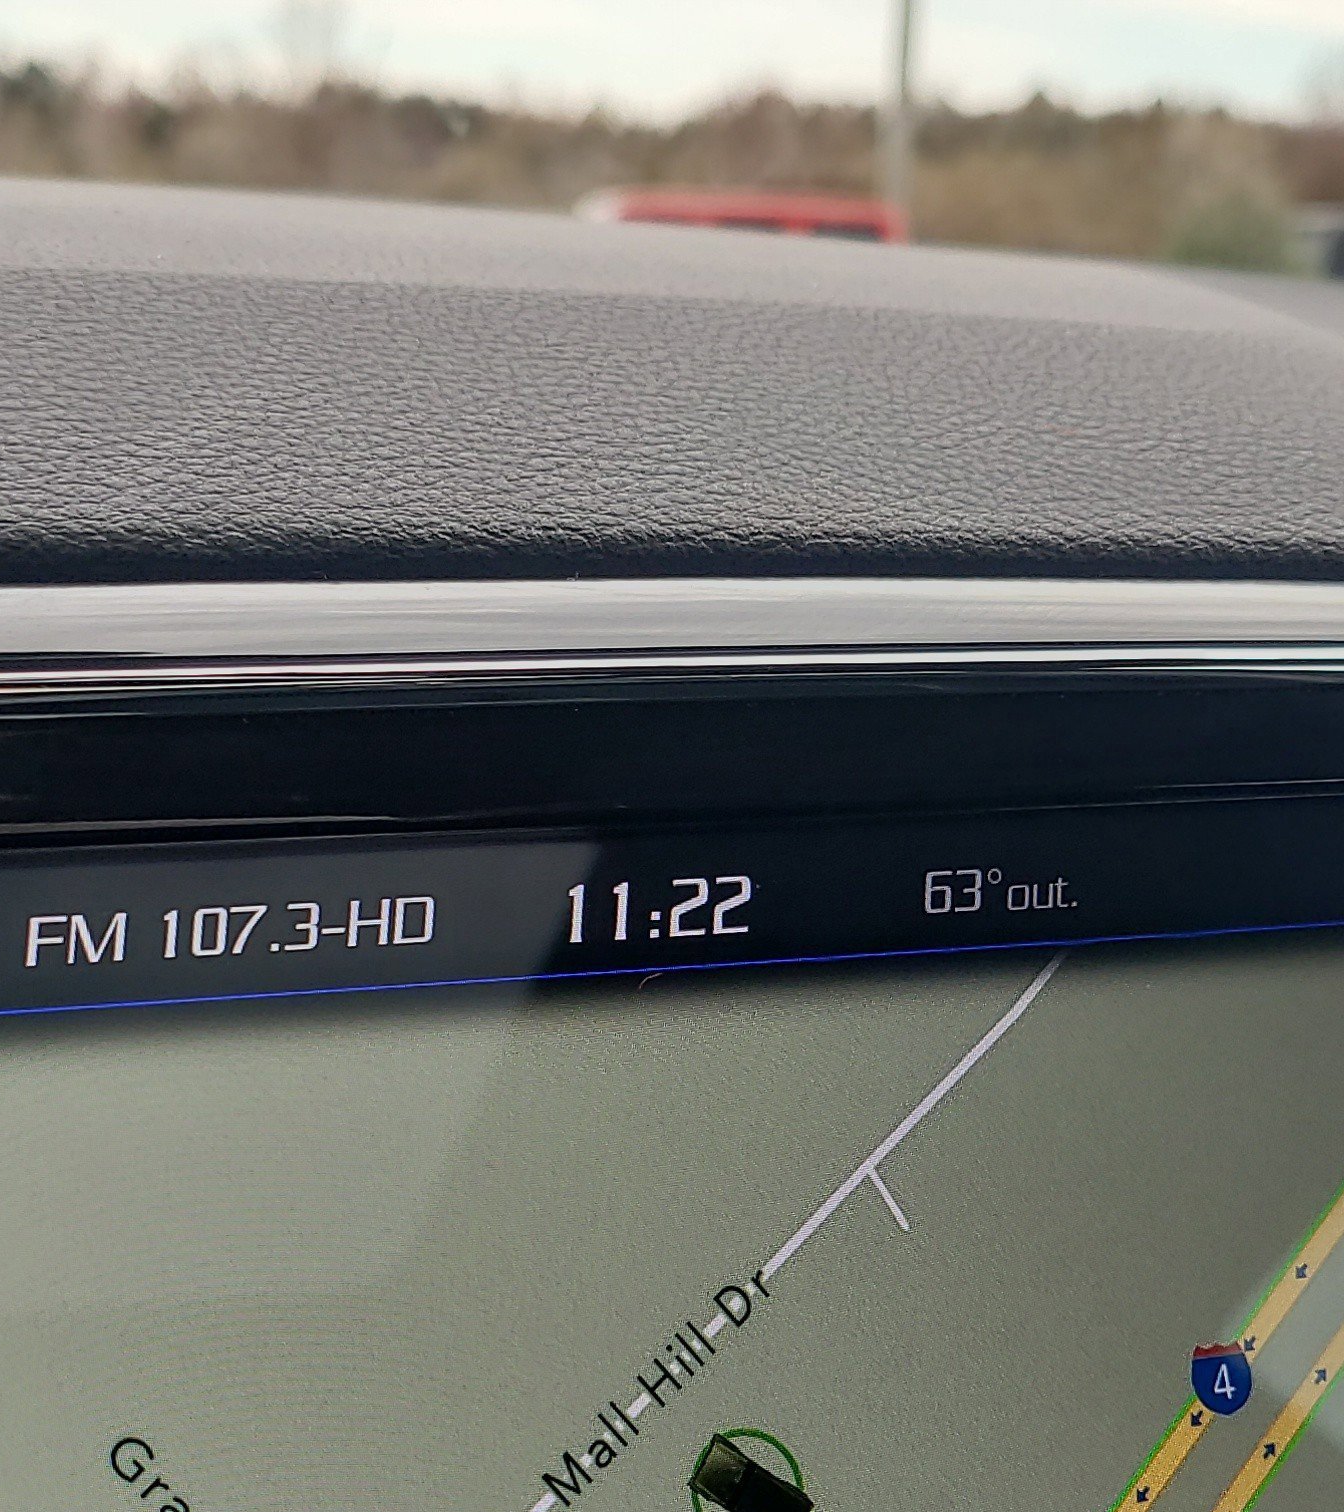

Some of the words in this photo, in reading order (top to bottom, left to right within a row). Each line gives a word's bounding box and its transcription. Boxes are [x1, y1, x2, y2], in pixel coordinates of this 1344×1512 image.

[23, 912, 128, 968] FM
[162, 896, 436, 960] 107.3-HD
[567, 875, 753, 944] 11:22
[542, 1402, 640, 1507] Mall
[637, 1321, 716, 1407] Hill
[713, 1270, 773, 1327] Dr
[1213, 1362, 1236, 1400] 4
